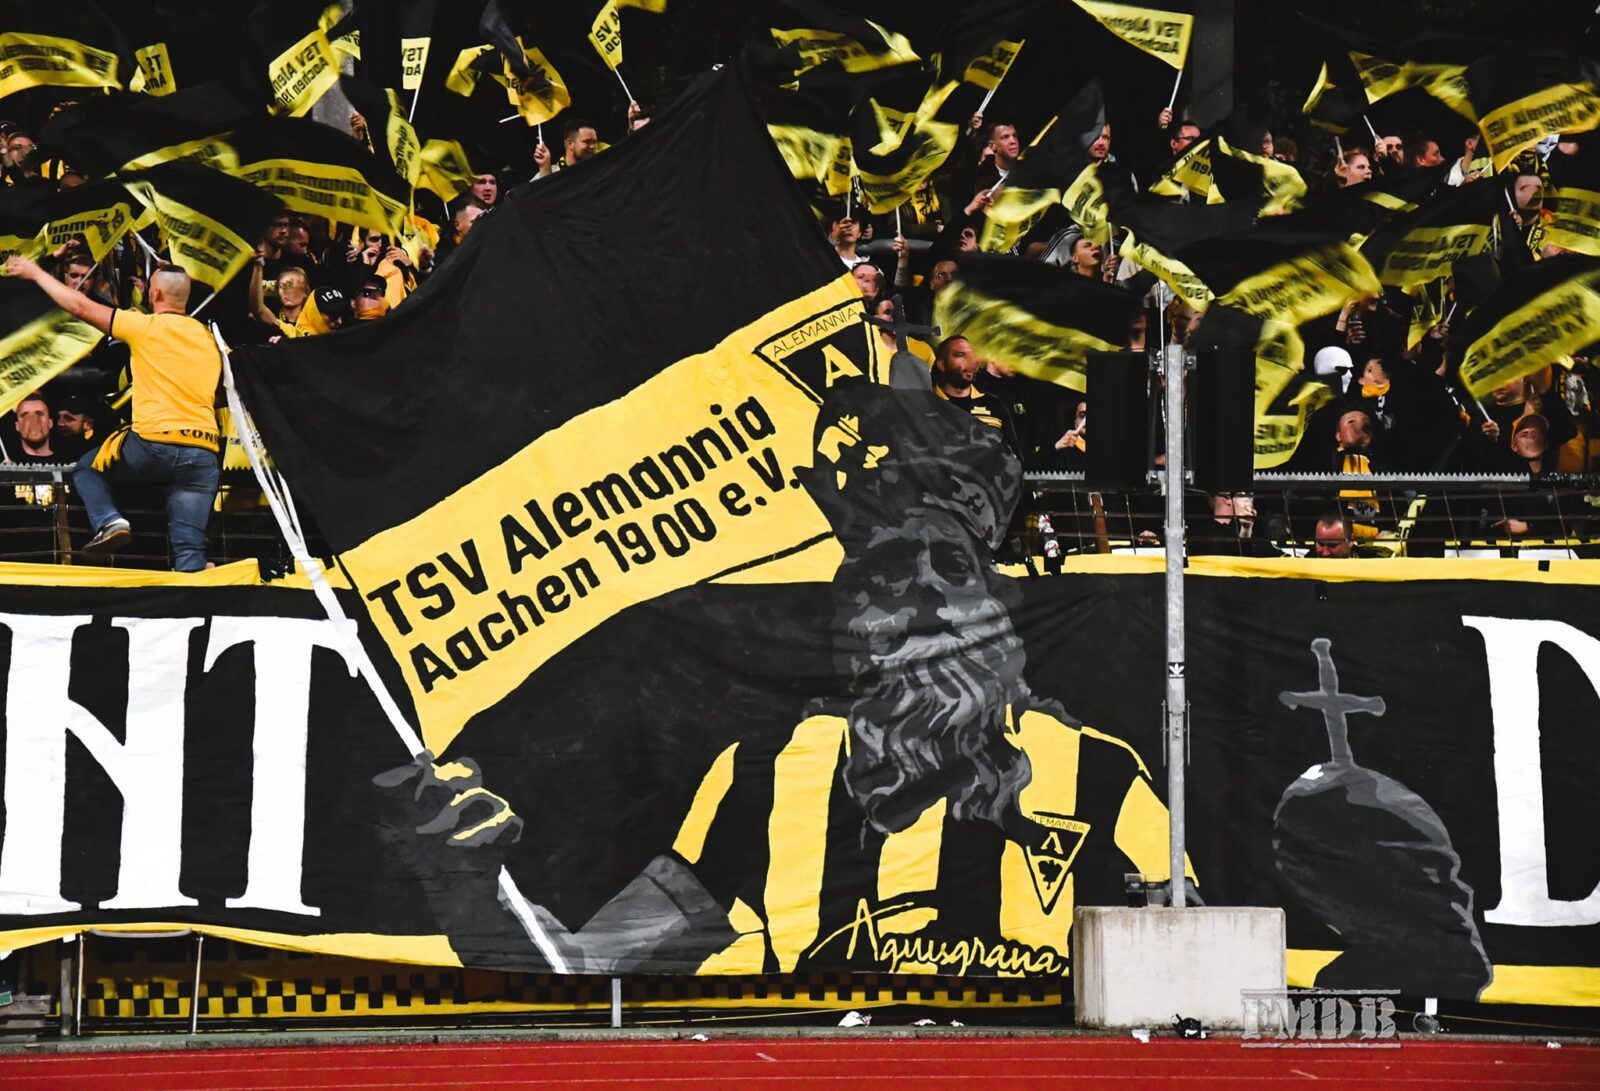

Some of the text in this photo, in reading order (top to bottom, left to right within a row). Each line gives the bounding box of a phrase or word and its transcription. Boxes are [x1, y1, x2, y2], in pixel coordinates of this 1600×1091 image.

[772, 306, 858, 359] ALEMANNIA
[821, 343, 865, 388] A
[367, 395, 777, 636] TSV Alemannia
[409, 446, 801, 693] Aachen 1900 e.V.
